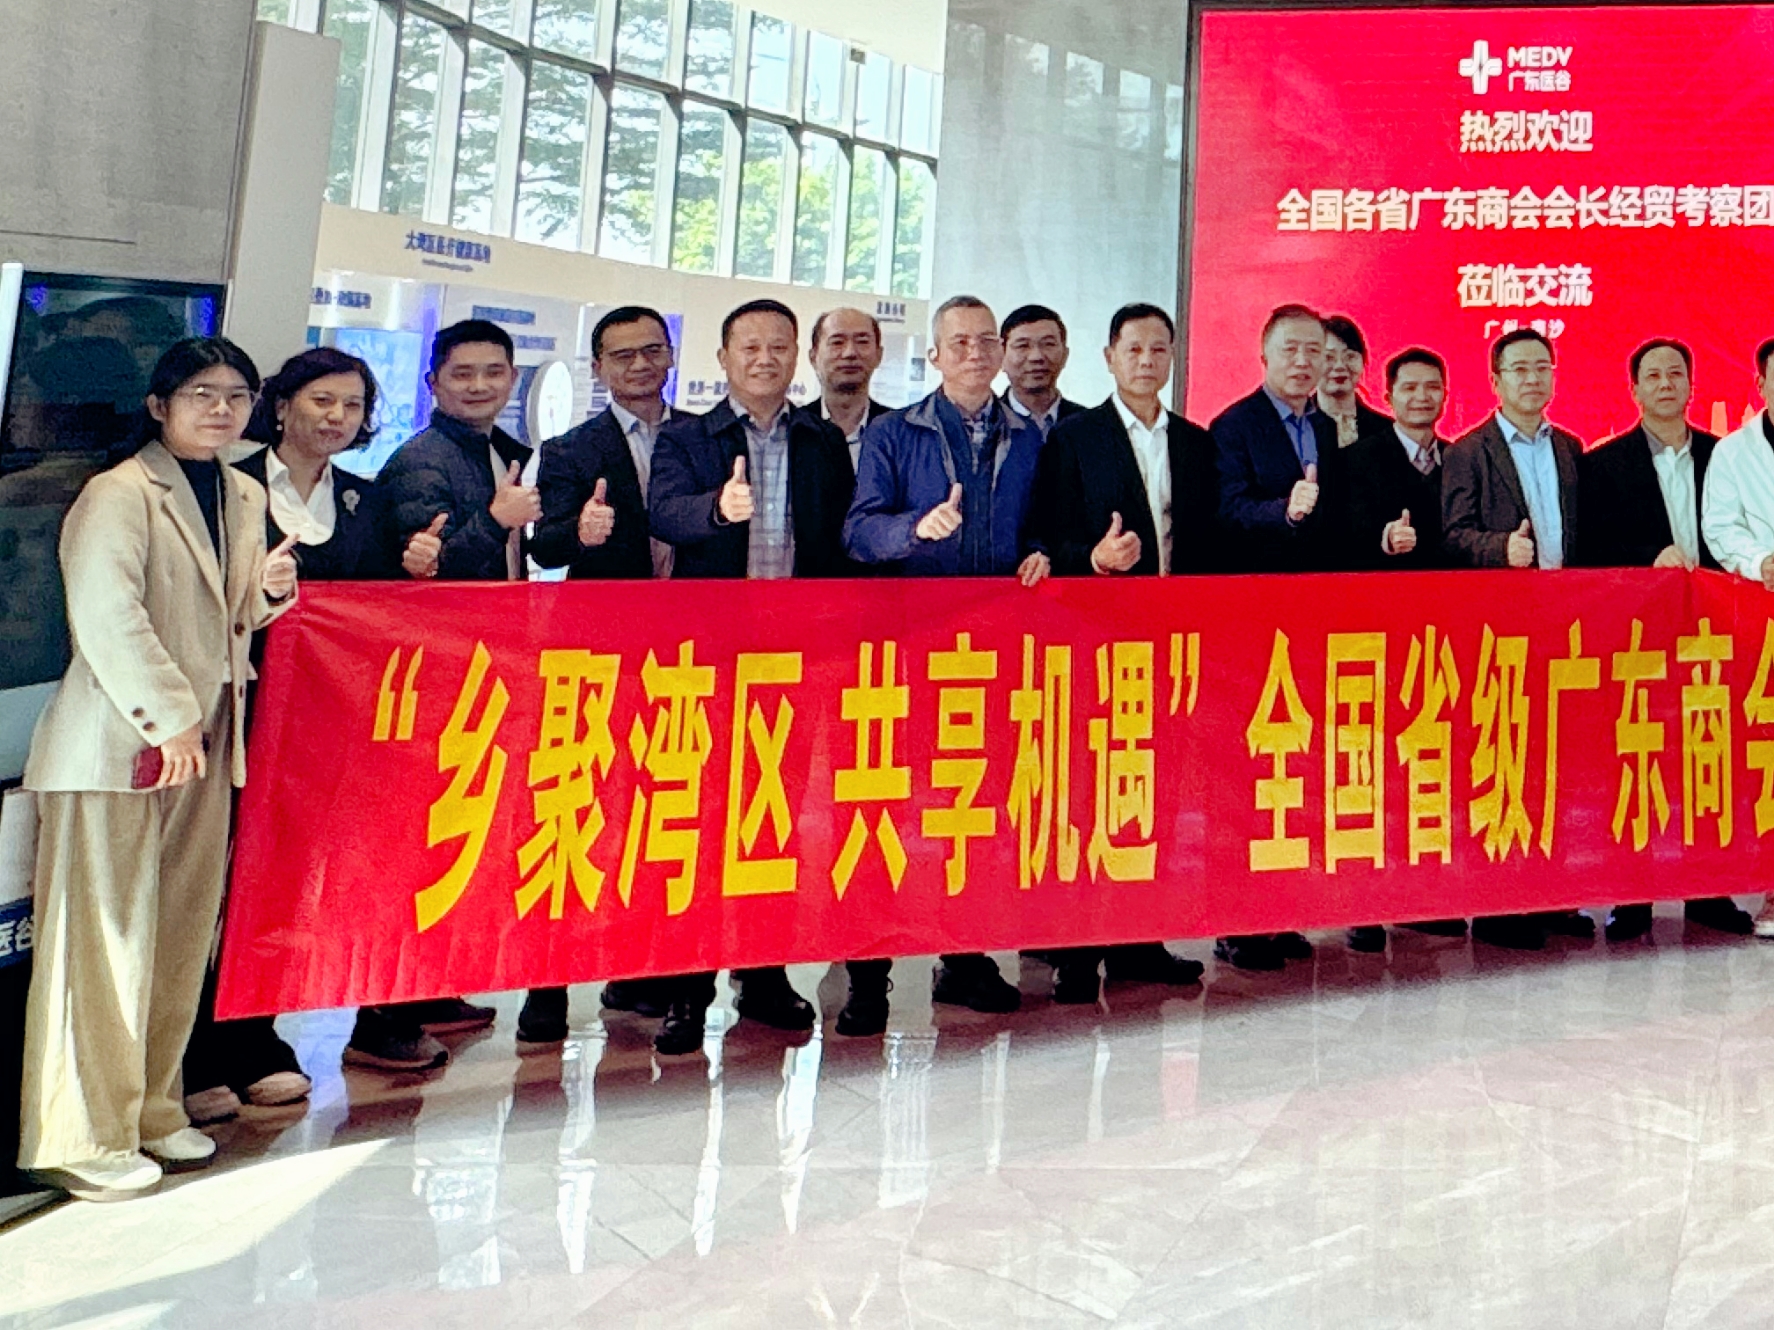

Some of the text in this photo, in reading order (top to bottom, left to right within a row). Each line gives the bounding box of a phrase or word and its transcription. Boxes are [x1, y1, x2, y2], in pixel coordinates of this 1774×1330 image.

[1506, 46, 1573, 68] MEDV
[1507, 70, 1572, 92] 广东医谷
[1459, 109, 1594, 154] 热烈欢迎
[1457, 262, 1594, 308] 莅临交流
[372, 638, 803, 934] “乡聚湾区
[832, 630, 1201, 901] 共享机遇”
